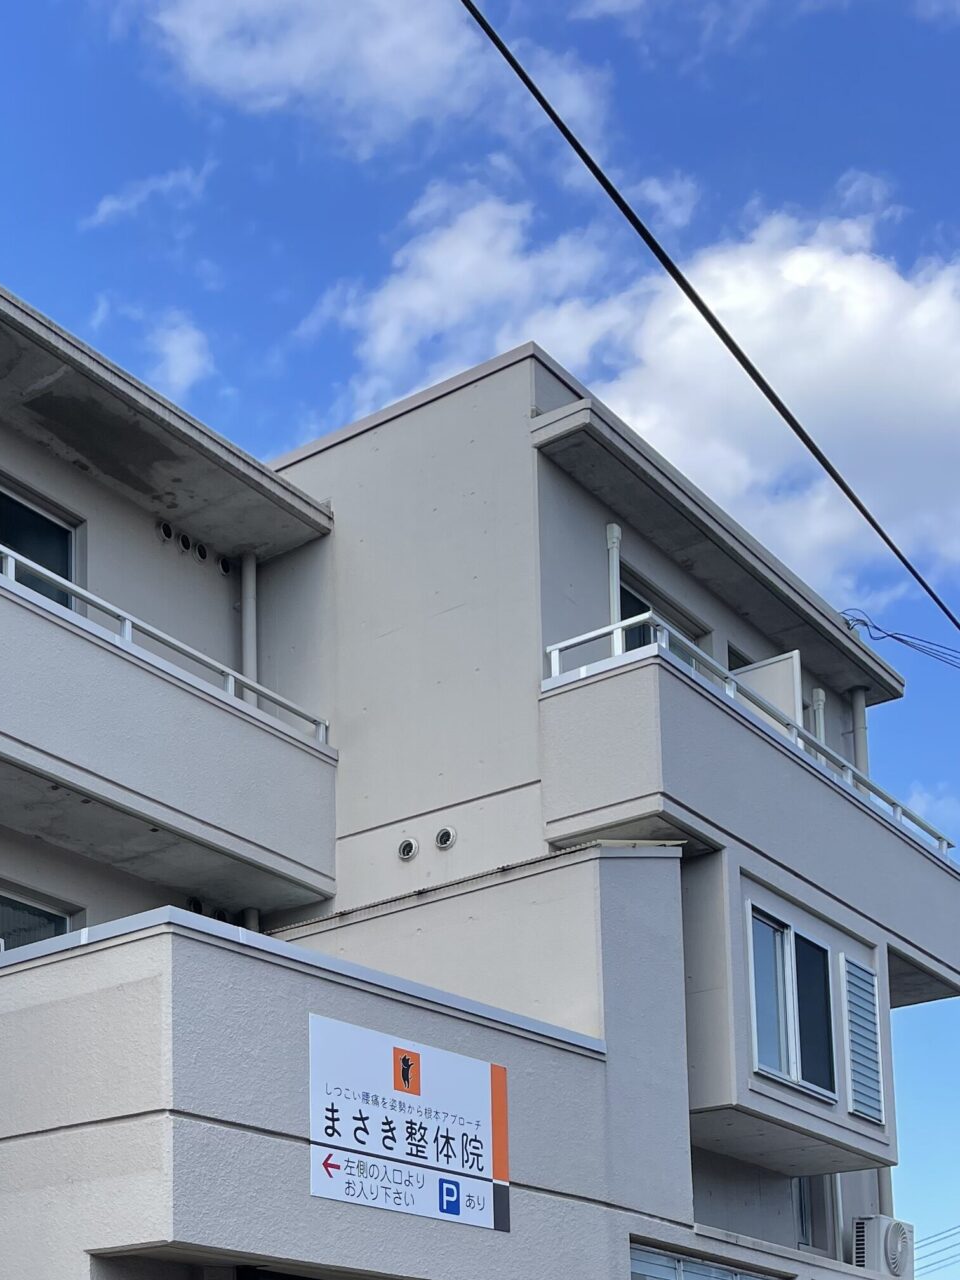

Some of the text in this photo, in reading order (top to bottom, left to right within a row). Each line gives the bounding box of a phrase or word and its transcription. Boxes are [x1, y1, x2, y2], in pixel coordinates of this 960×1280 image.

[325, 1082, 482, 1130] しつこい腰痛を姿勢から根本アプローチ
[324, 1102, 484, 1172] まさき整体院
[344, 1158, 425, 1189] 左側の入口より
[344, 1180, 415, 1207] お入り下さい
[465, 1193, 486, 1211] あり
